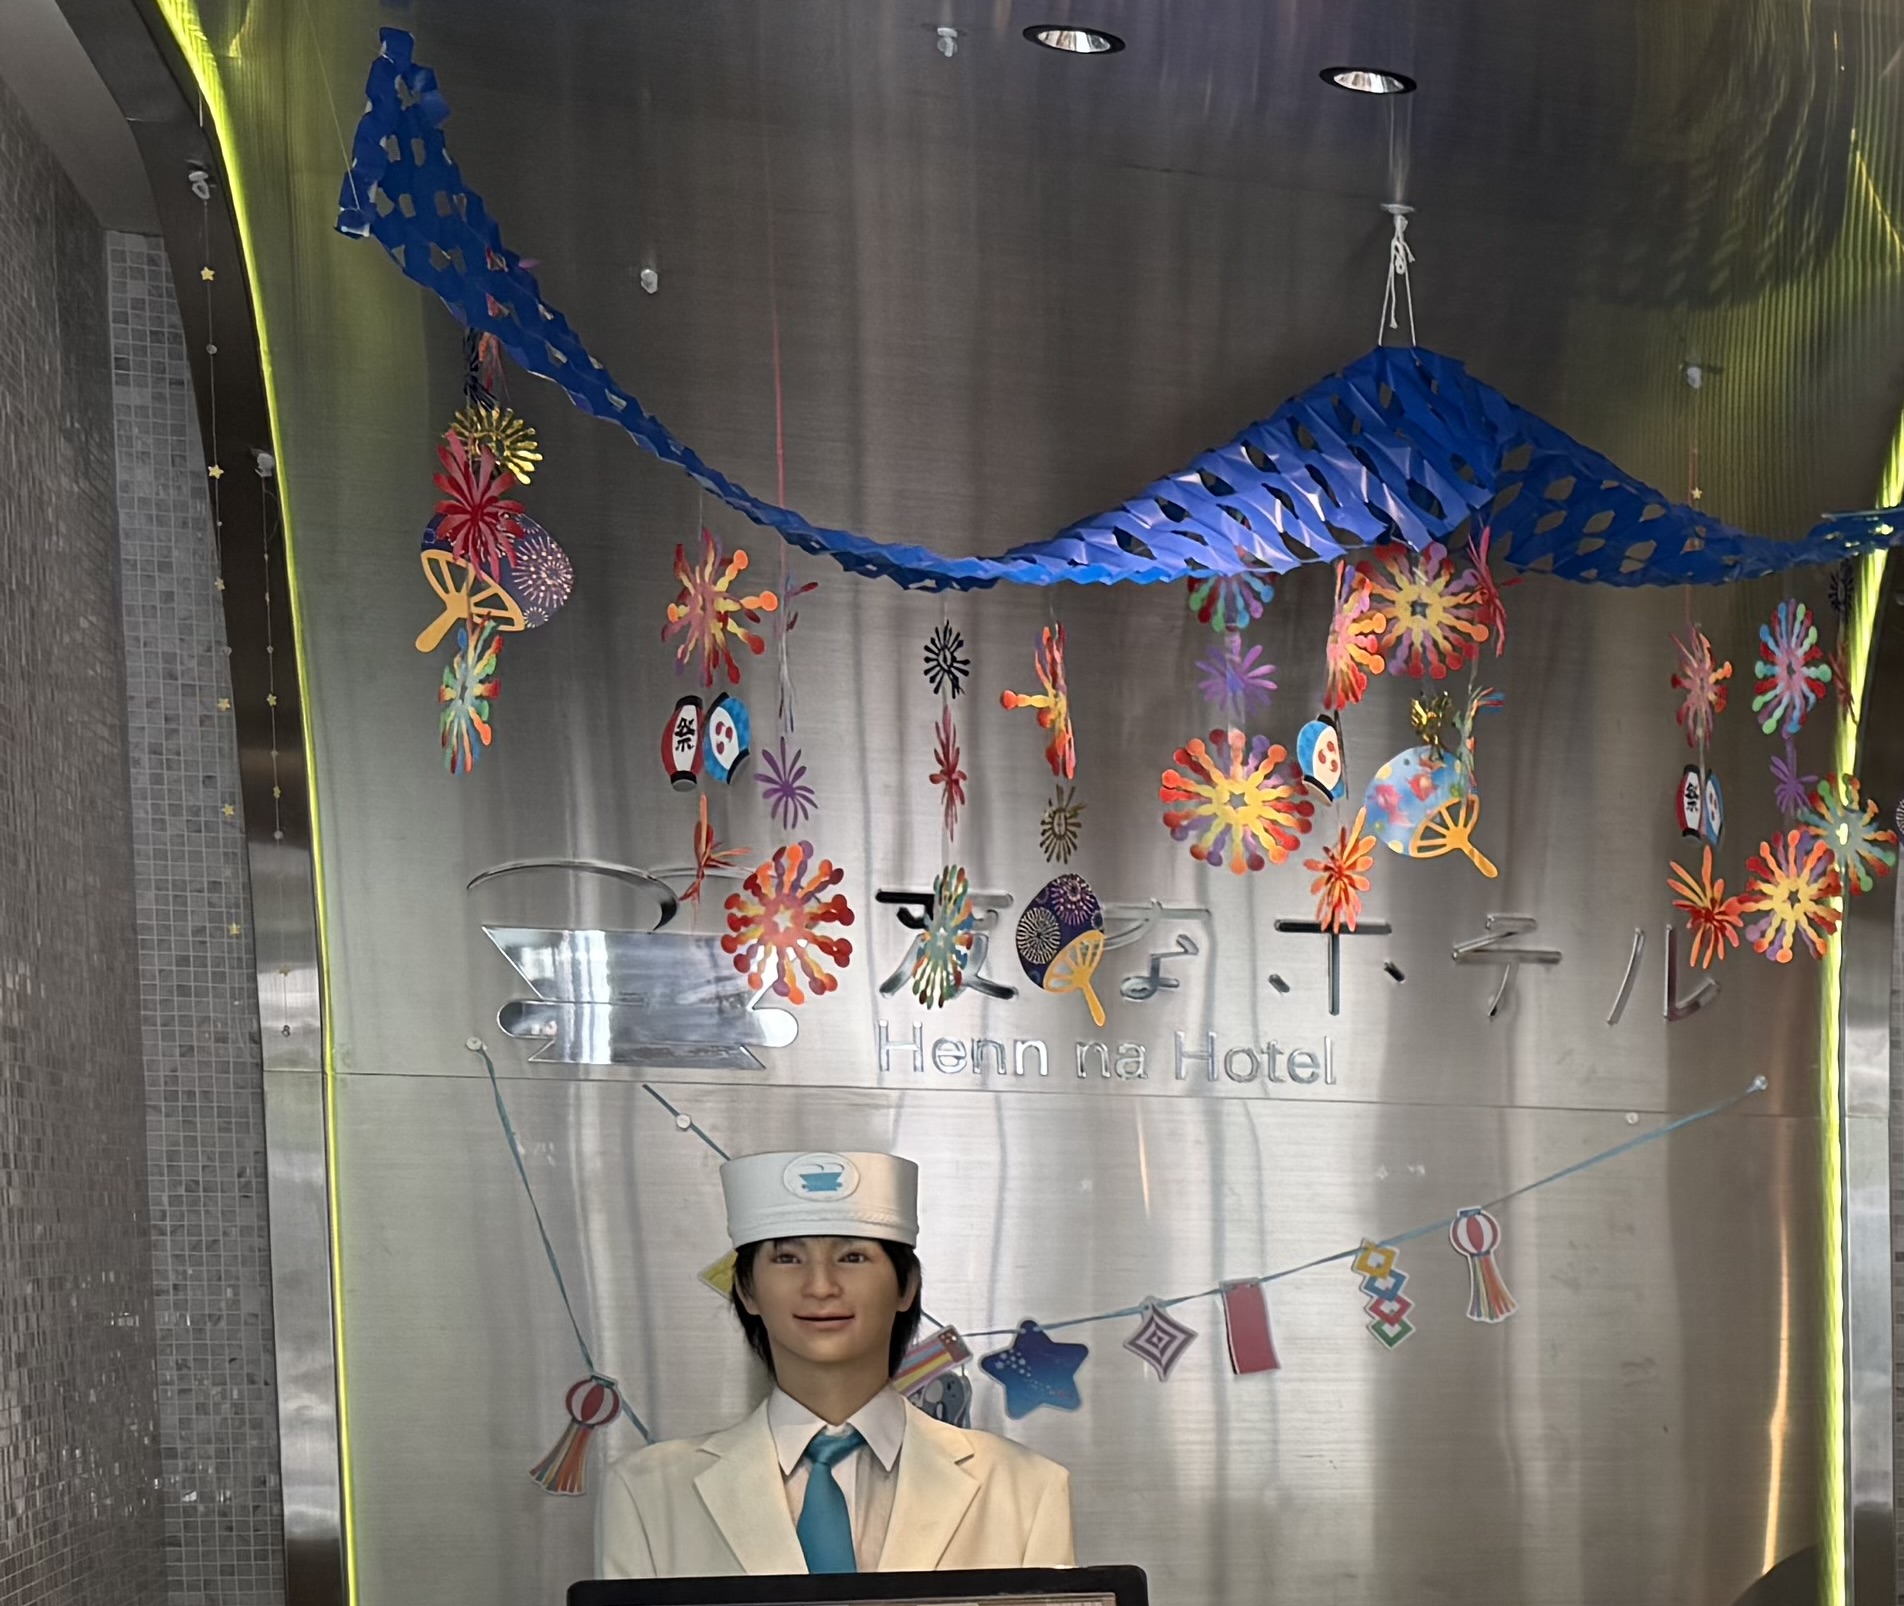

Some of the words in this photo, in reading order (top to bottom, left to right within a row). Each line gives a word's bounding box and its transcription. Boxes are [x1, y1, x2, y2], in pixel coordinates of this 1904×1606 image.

[675, 717, 695, 752] 祭
[877, 1020, 1049, 1076] Henn
[1076, 1040, 1149, 1080] na
[1174, 1030, 1337, 1085] Hotel
